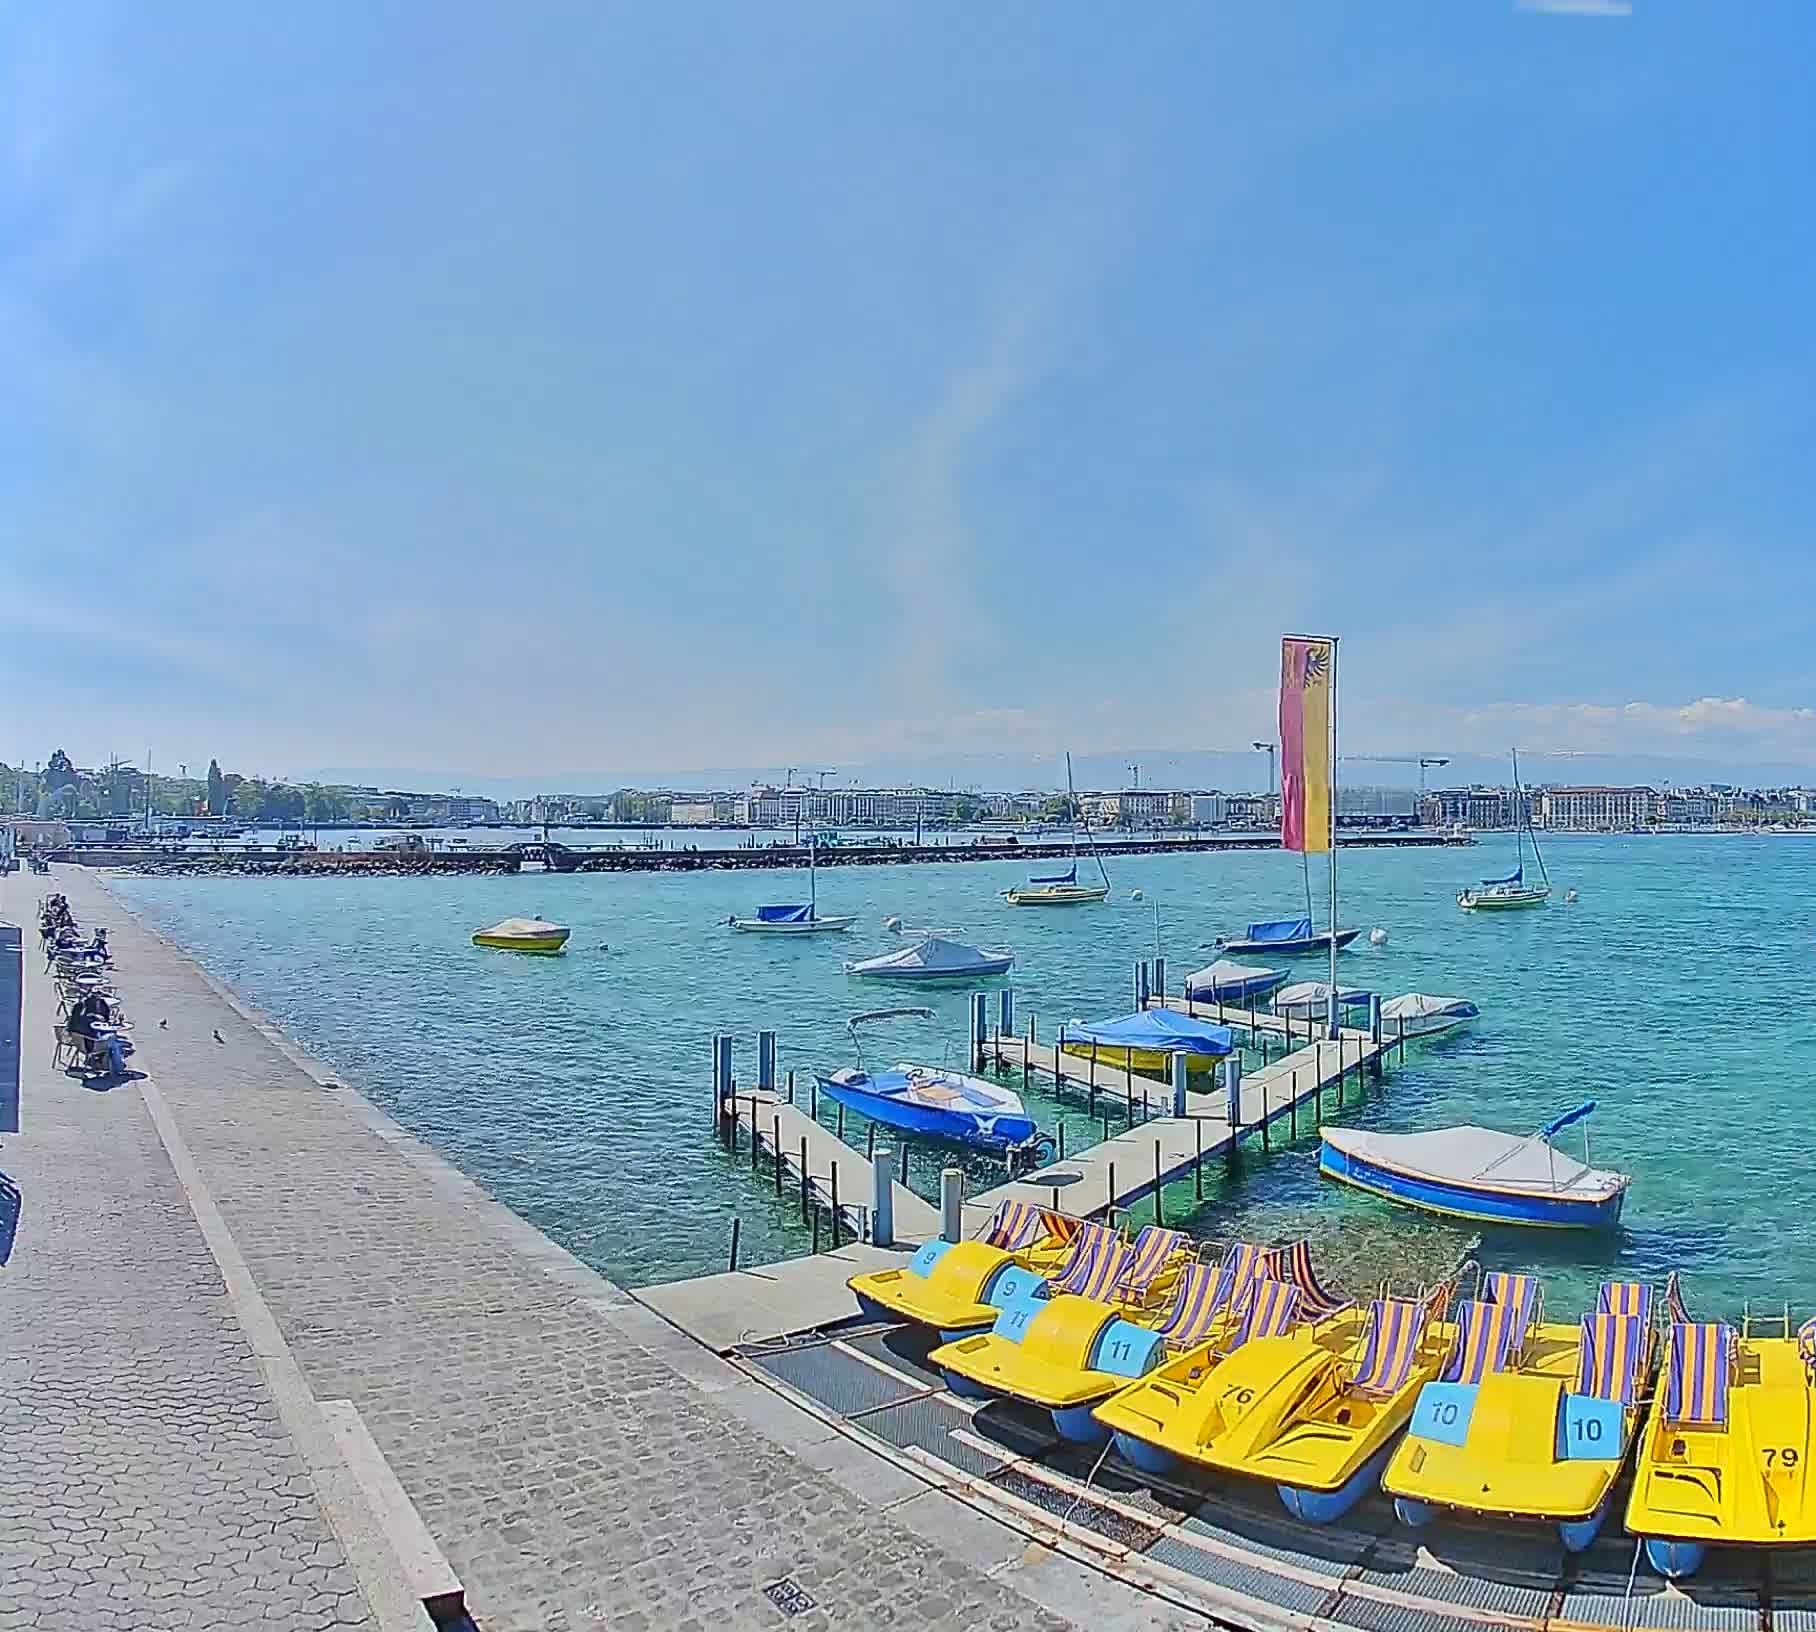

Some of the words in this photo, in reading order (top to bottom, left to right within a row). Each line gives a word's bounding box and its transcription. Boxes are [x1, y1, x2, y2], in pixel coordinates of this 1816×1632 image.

[1002, 1281, 1017, 1297] 9
[1010, 1311, 1028, 1328] 11
[1111, 1340, 1132, 1361] 11
[1222, 1383, 1255, 1404] 76
[1432, 1399, 1459, 1425] 10
[1572, 1418, 1602, 1441] 10
[1761, 1448, 1799, 1468] 79
